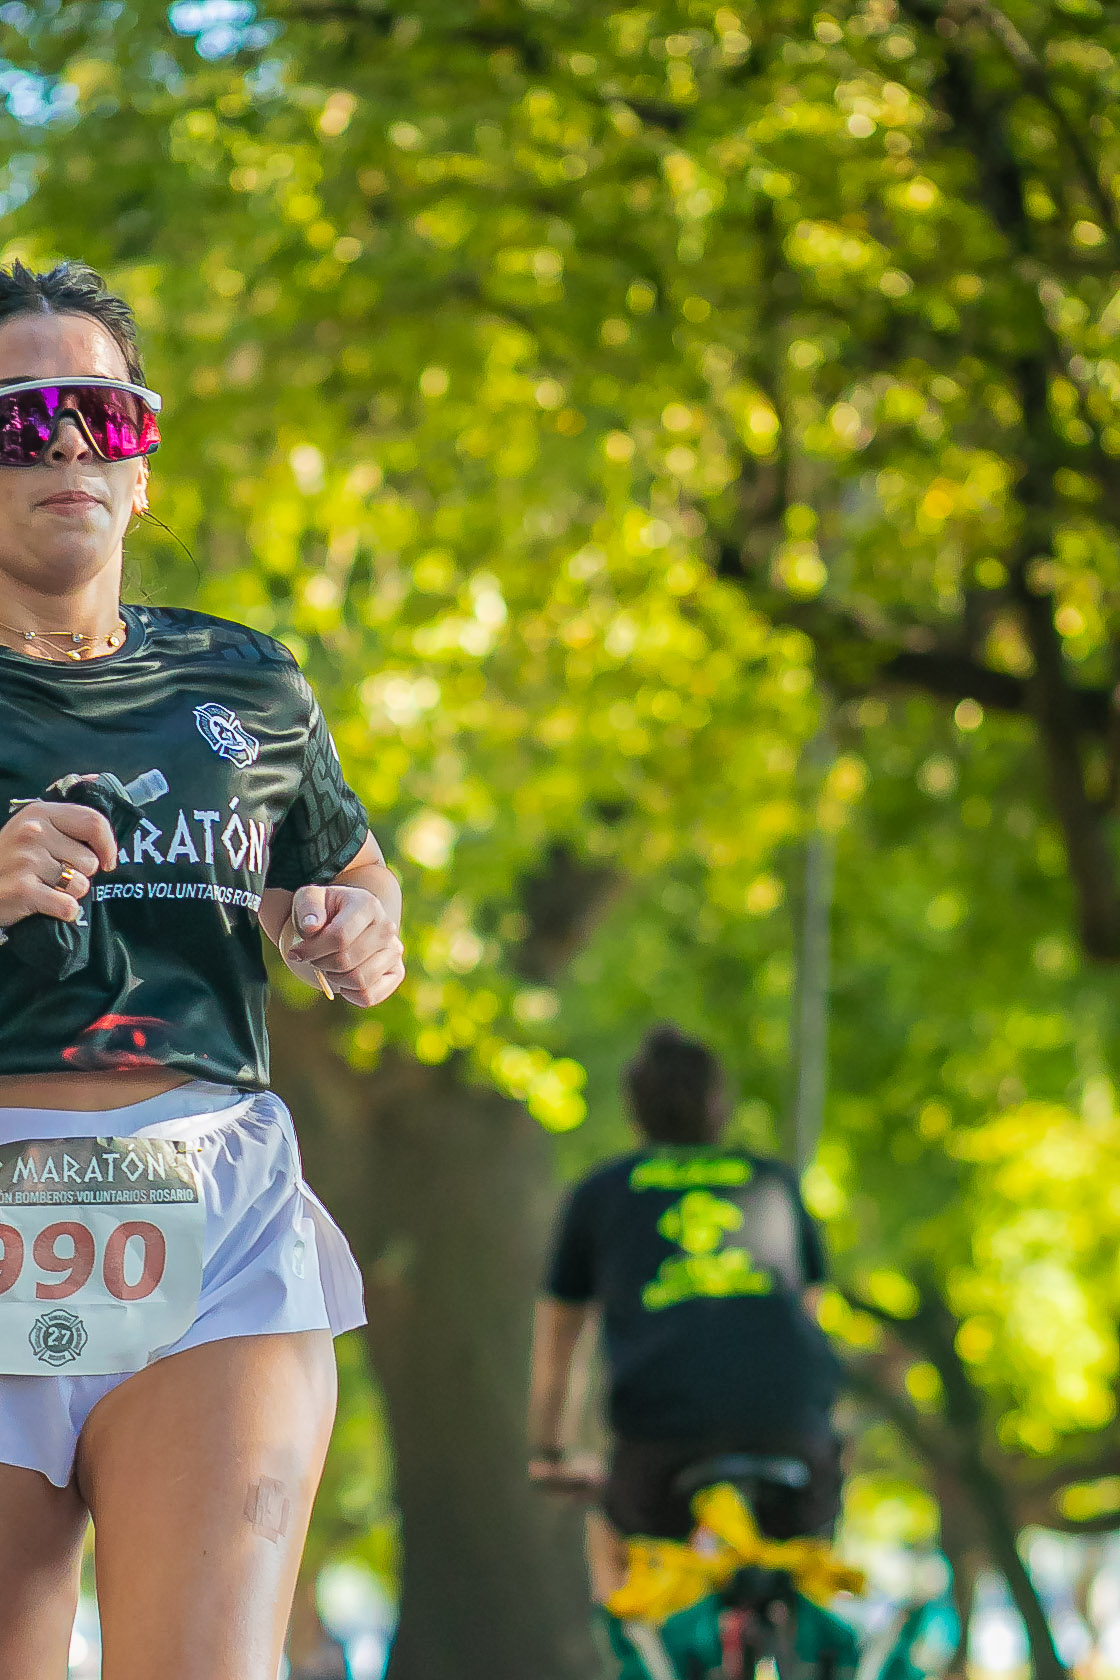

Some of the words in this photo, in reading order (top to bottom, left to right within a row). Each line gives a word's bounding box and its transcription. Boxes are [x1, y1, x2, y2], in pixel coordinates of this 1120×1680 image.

[118, 796, 266, 875] RATÓN
[91, 882, 145, 902] BEROS
[11, 1143, 166, 1185] MARATÓN
[15, 1190, 75, 1205] BOMBEROS
[76, 1189, 147, 1203] VOLUNTARIOS
[149, 1187, 195, 1203] ROSARIO
[47, 1326, 71, 1346] 27
